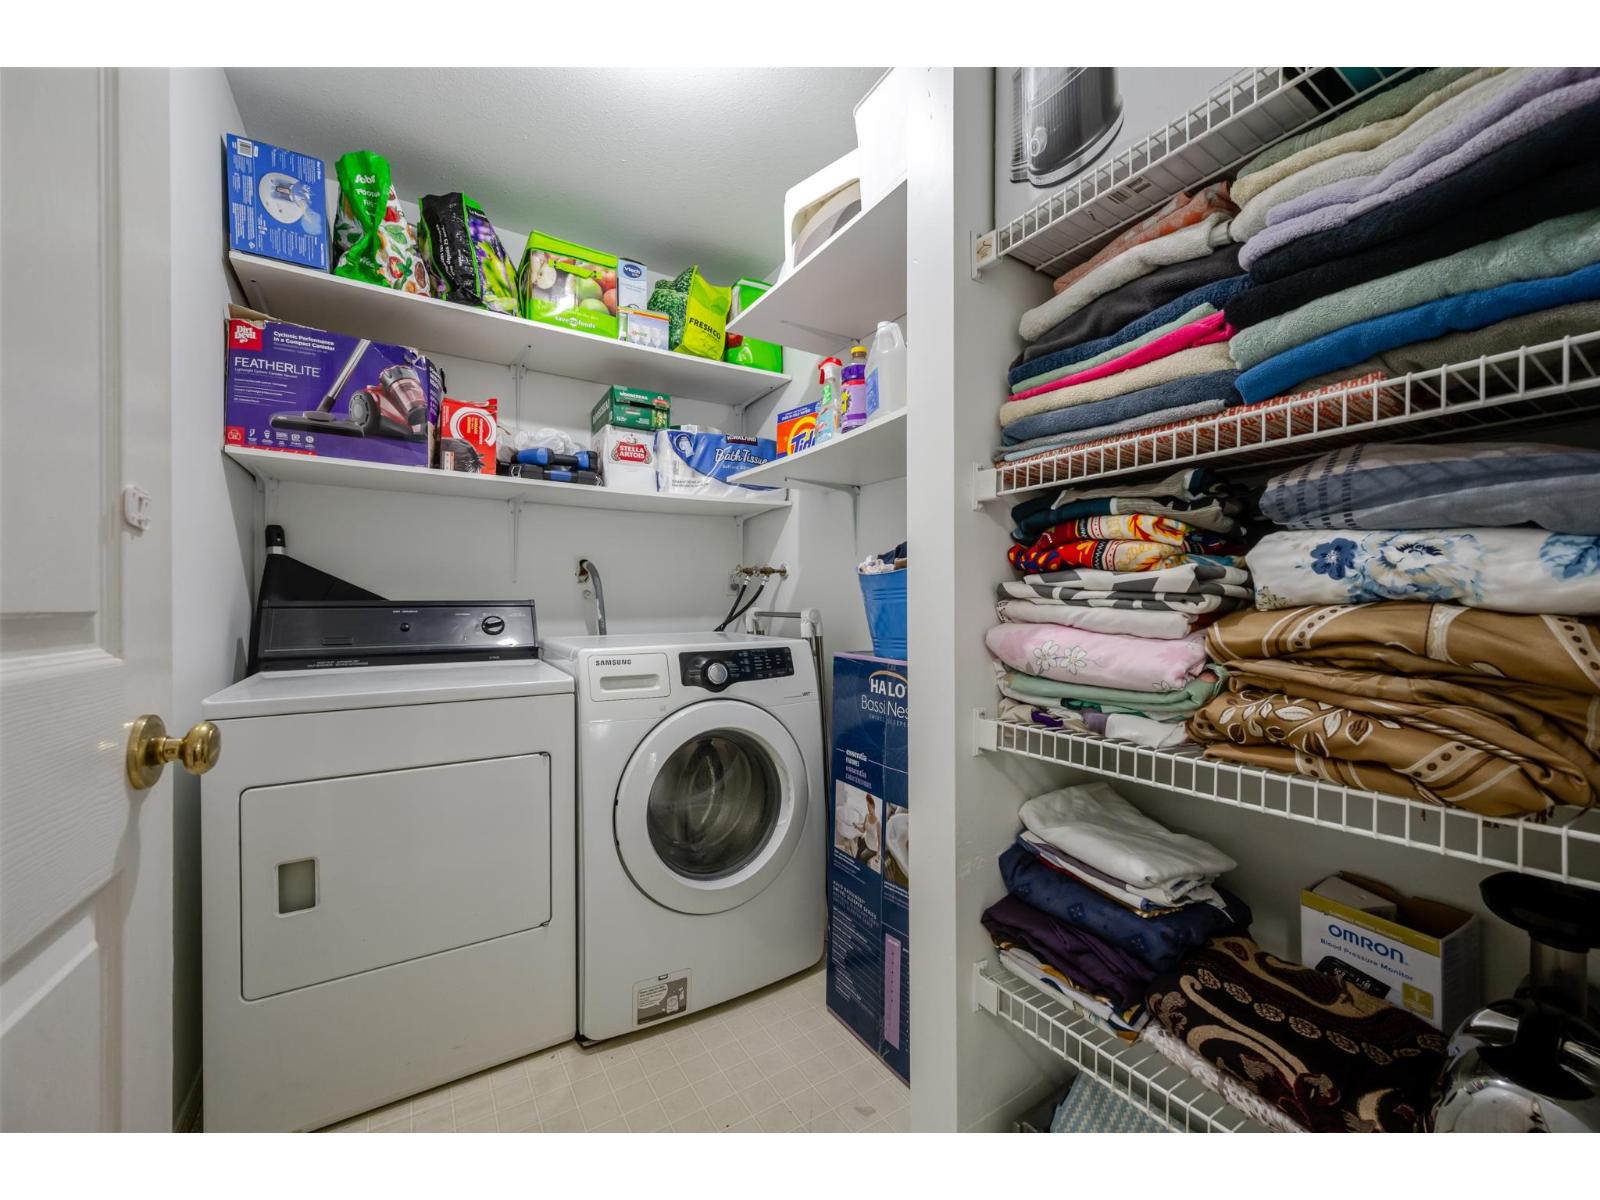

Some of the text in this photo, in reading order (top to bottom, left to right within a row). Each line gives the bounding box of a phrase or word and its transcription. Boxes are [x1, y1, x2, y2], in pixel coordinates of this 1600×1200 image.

[234, 331, 257, 342] Devil
[236, 325, 254, 334] Dirt
[273, 331, 335, 346] Cyclonic Performance
[285, 339, 311, 348] Compact
[311, 343, 336, 352] Canister
[234, 356, 322, 378] FEATHERLITE
[619, 445, 645, 453] STELLA
[791, 430, 816, 453] Tid
[619, 451, 645, 459] ARTOIS
[714, 448, 743, 463] Bath
[595, 658, 632, 667] SAMSUNG
[870, 678, 906, 699] HALO
[1328, 924, 1404, 965] OMRON
[1320, 938, 1414, 981] Blood Pressure Monitor
